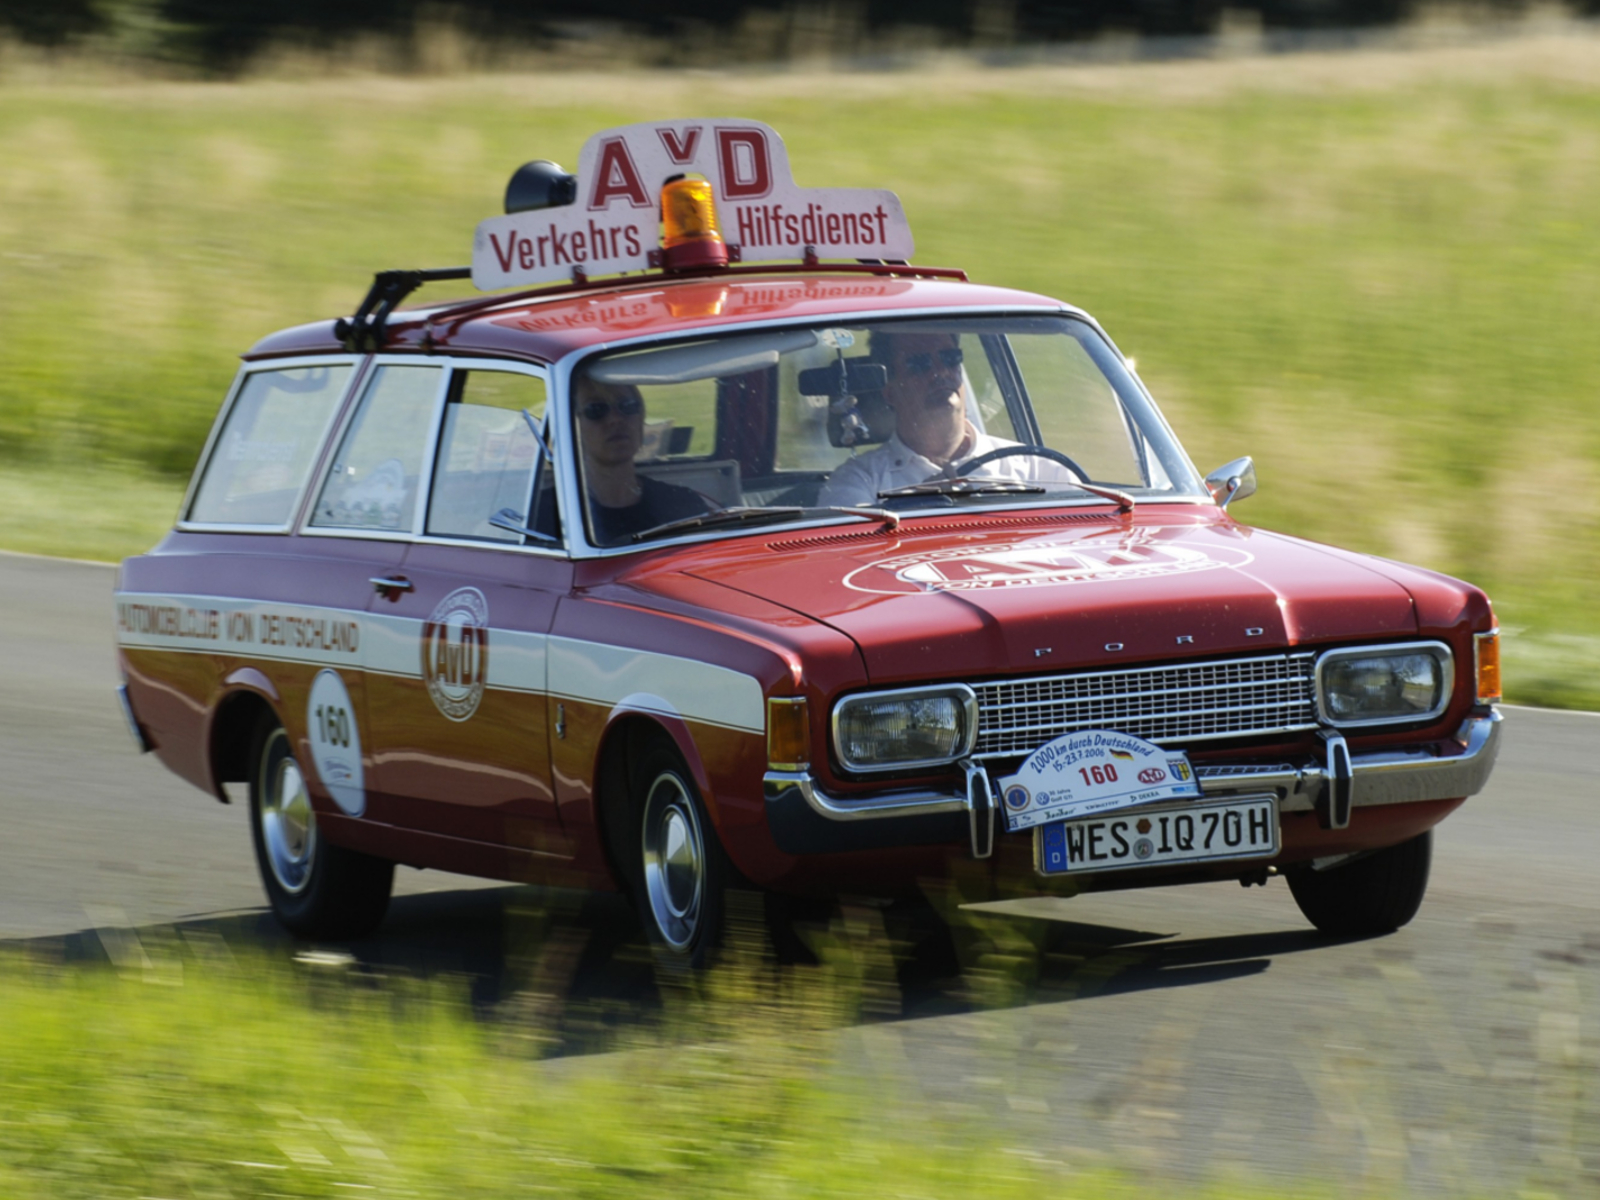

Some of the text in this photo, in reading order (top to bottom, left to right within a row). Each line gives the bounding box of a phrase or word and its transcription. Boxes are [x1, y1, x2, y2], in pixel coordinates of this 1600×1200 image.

[488, 203, 888, 273] Verkehrs Hilfsdienst
[226, 610, 255, 643] VON
[1035, 626, 1264, 657] FORD
[315, 704, 350, 748] 160
[1030, 746, 1055, 774] 2000
[1068, 735, 1092, 751] durch
[1093, 733, 1155, 757] Deutschland
[1078, 763, 1118, 786] 160
[1138, 791, 1160, 800] DEKRA
[1066, 821, 1130, 863] WES
